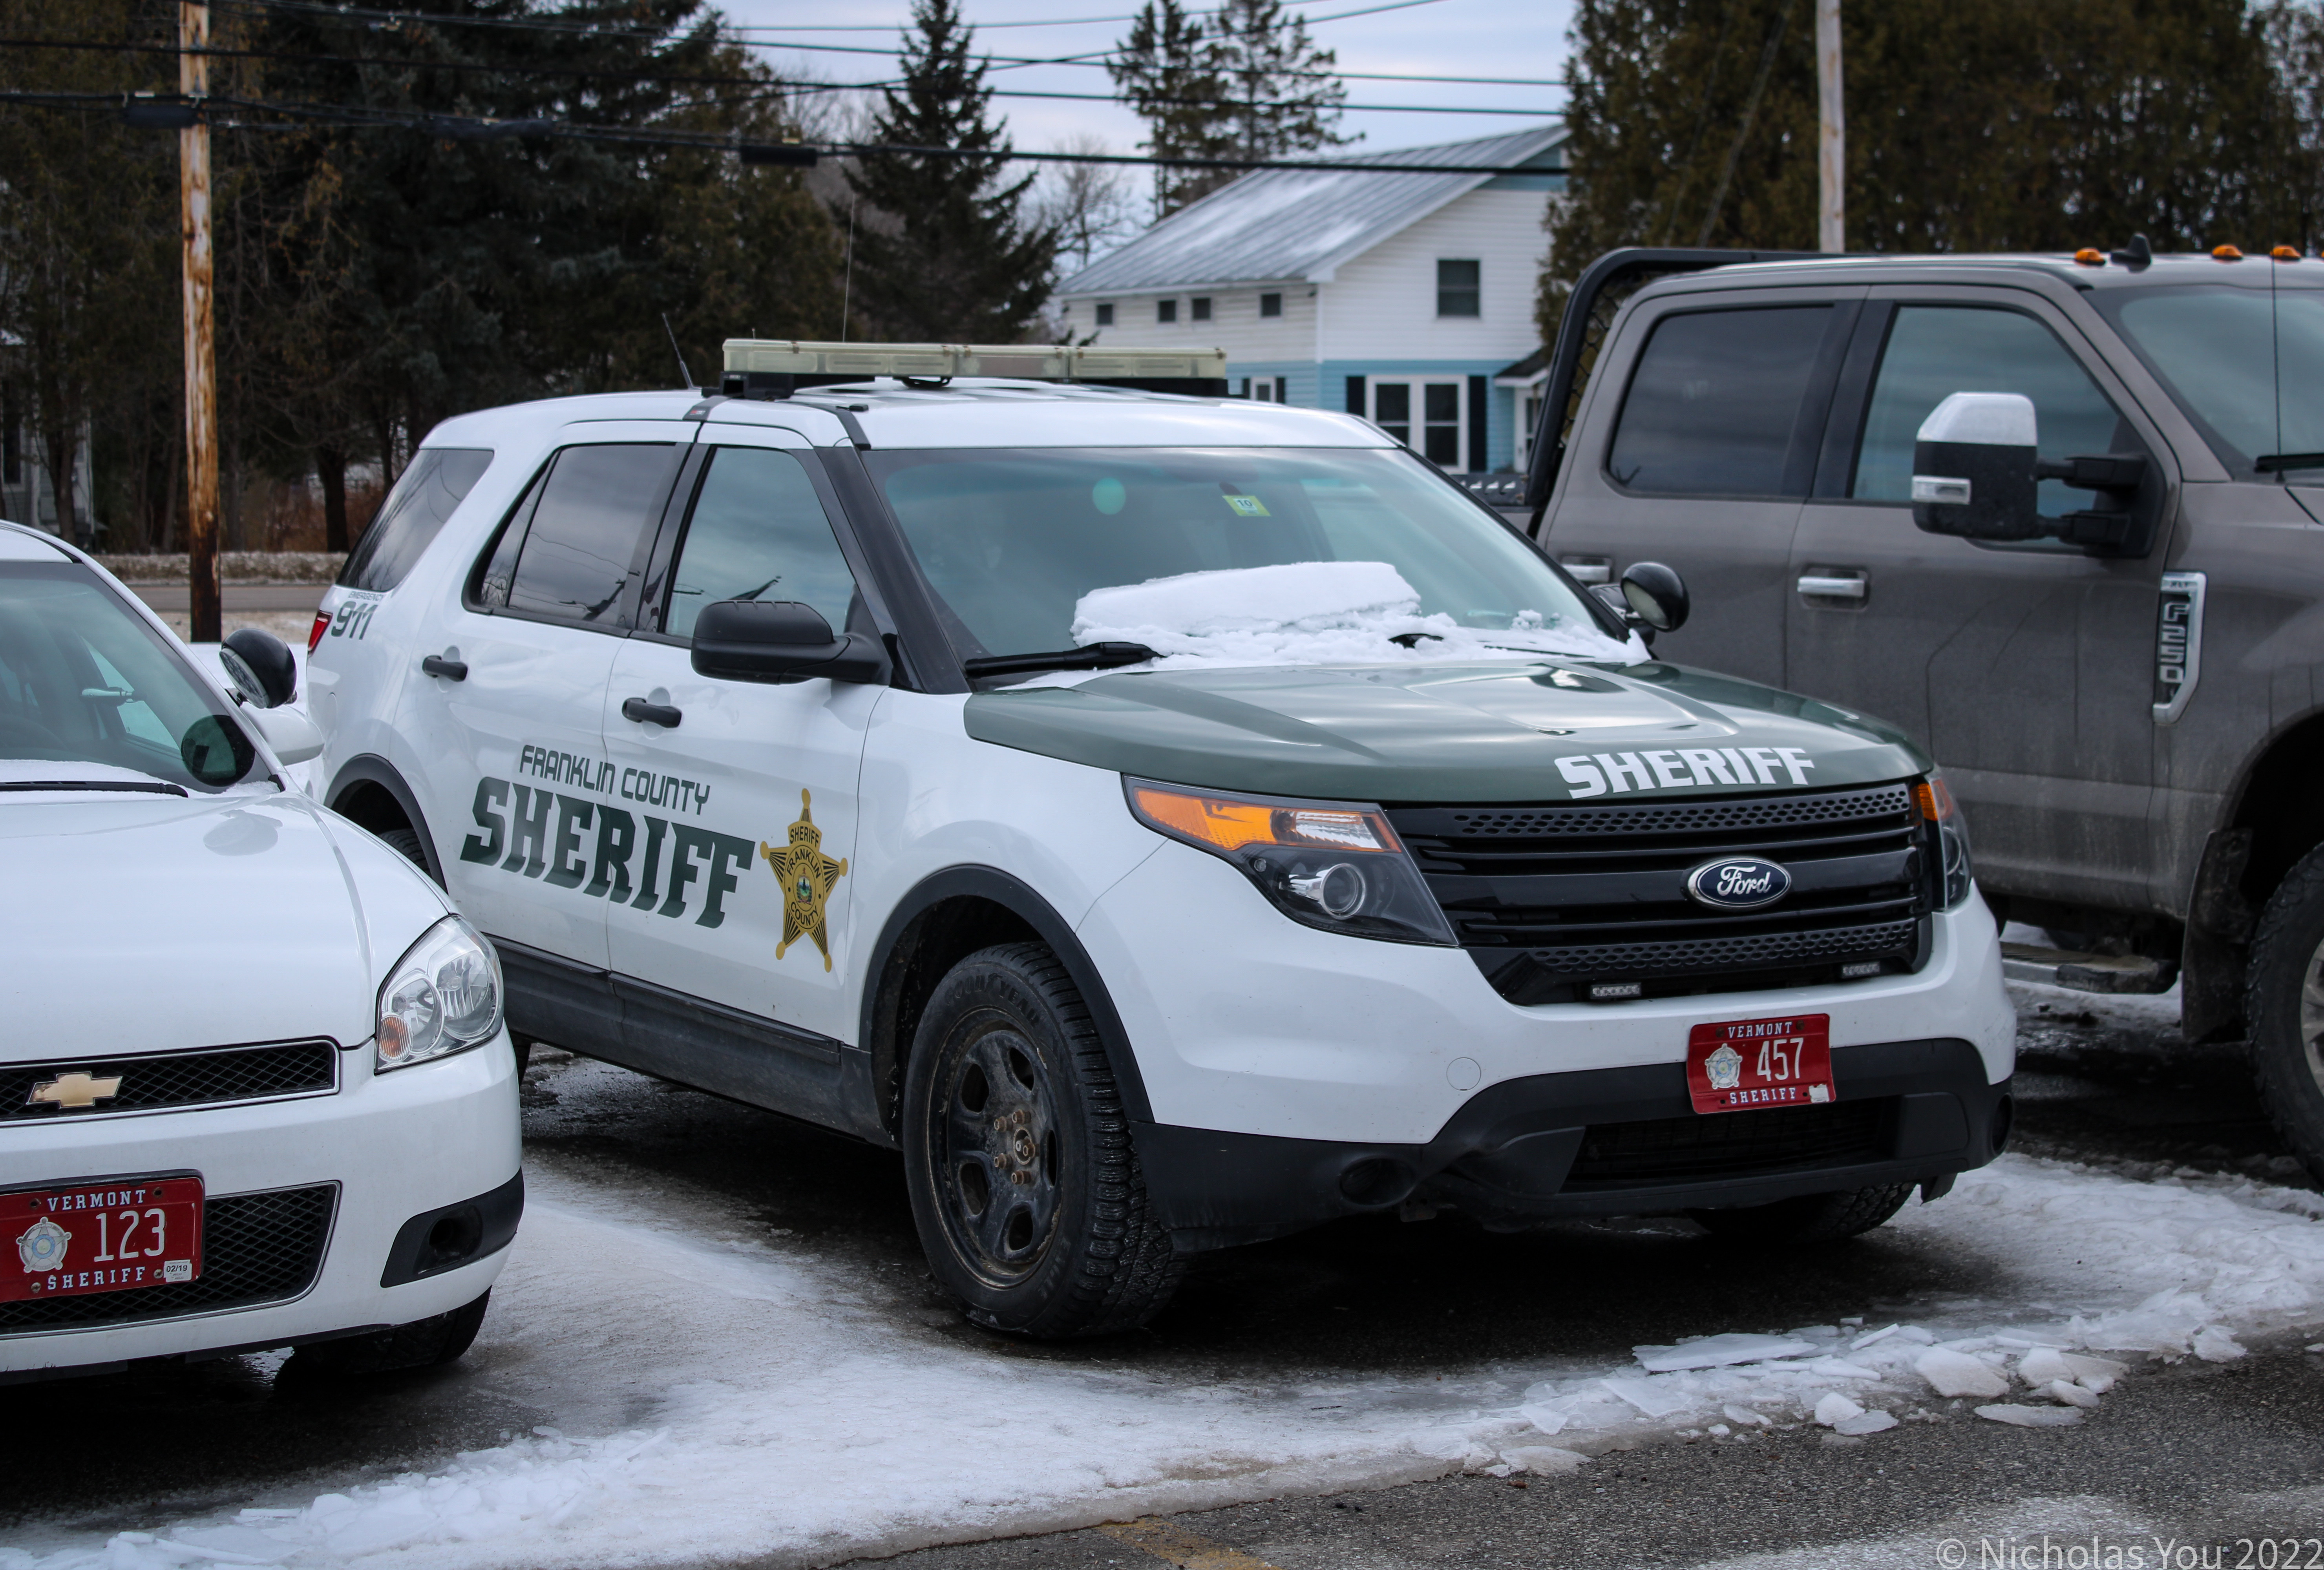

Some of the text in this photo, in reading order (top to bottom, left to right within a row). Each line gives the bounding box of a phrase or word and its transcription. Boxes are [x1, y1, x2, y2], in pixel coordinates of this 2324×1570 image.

[348, 590, 384, 602] EMERGENCY
[331, 601, 378, 640] 911
[519, 745, 710, 816] FRANKLIN COUNTY
[1554, 748, 1815, 799] SHERIFF
[790, 826, 819, 848] SHERIFF
[459, 776, 756, 929] SHERIFF
[787, 849, 821, 879] FRANKLIN
[1717, 865, 1771, 896] Ford
[791, 902, 819, 926] COUNTY
[1728, 1022, 1792, 1038] VERMONT
[1757, 1037, 1804, 1081] 457
[1730, 1087, 1796, 1104] SHERIFF
[48, 1190, 146, 1211] VERMONT
[94, 1208, 165, 1262] 123
[48, 1267, 146, 1290] SHERIFF
